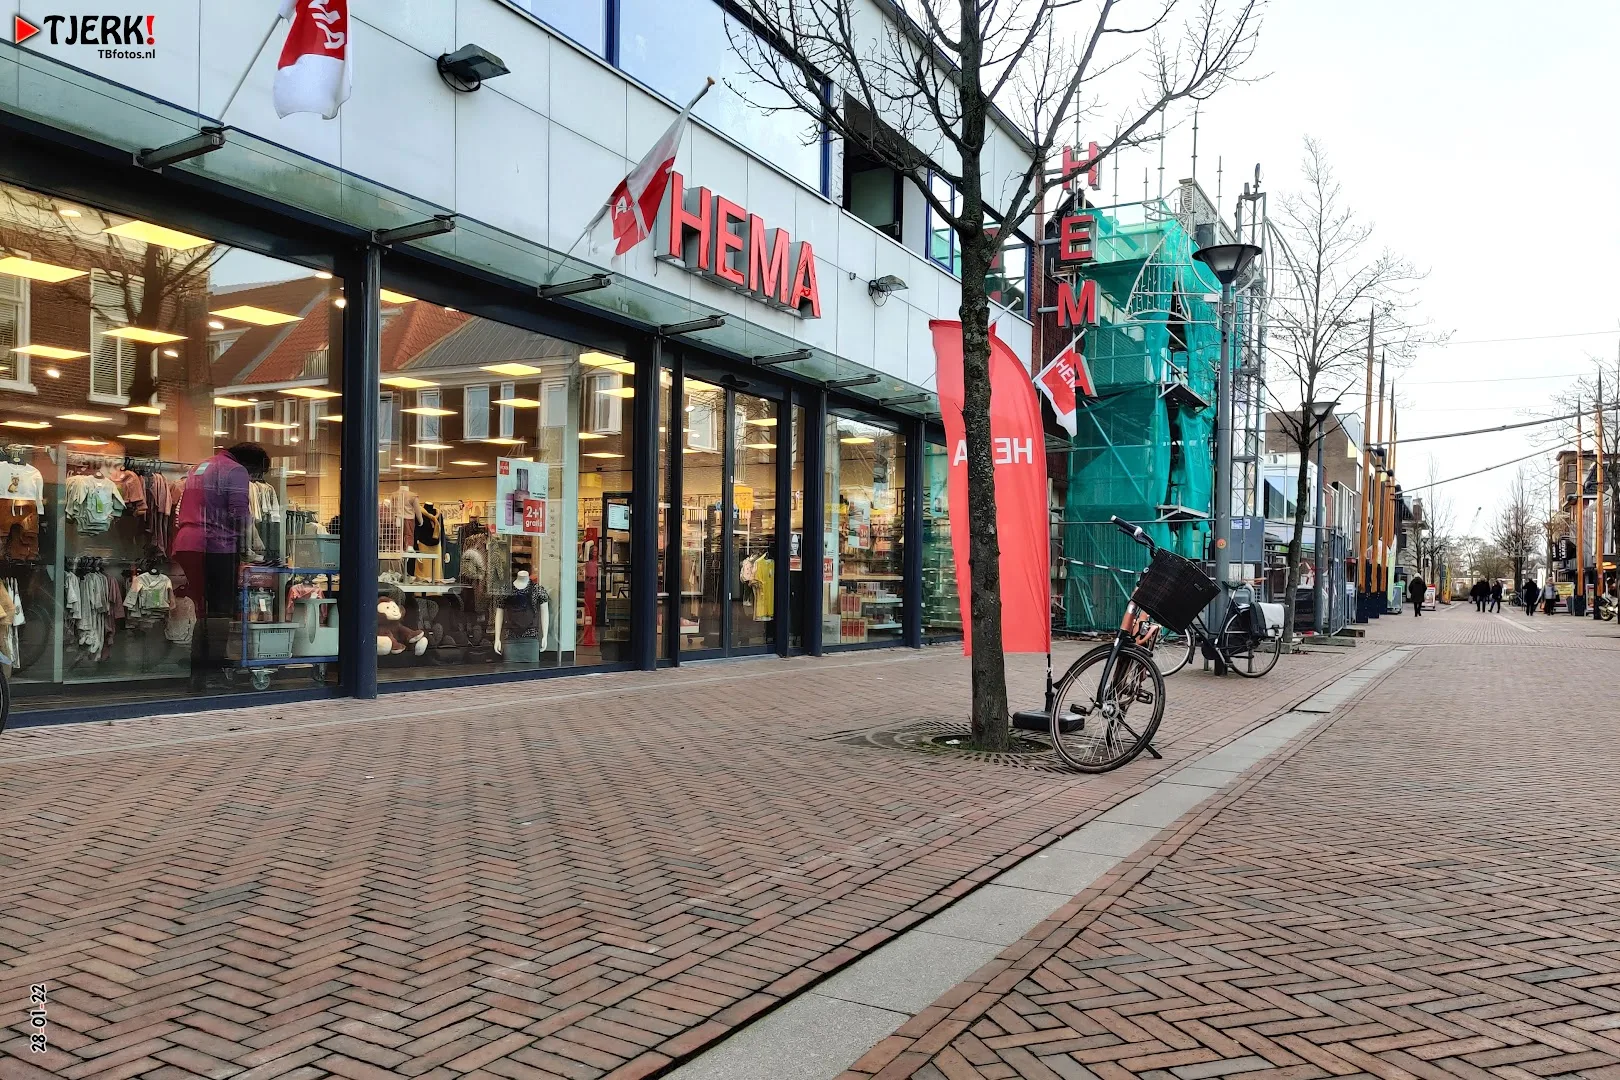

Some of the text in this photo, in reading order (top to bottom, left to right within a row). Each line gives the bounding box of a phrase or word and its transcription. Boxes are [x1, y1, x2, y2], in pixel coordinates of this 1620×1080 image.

[668, 170, 821, 320] HEMA
[1055, 358, 1076, 393] HEM
[525, 520, 542, 528] gratis
[526, 506, 542, 519] 2+1
